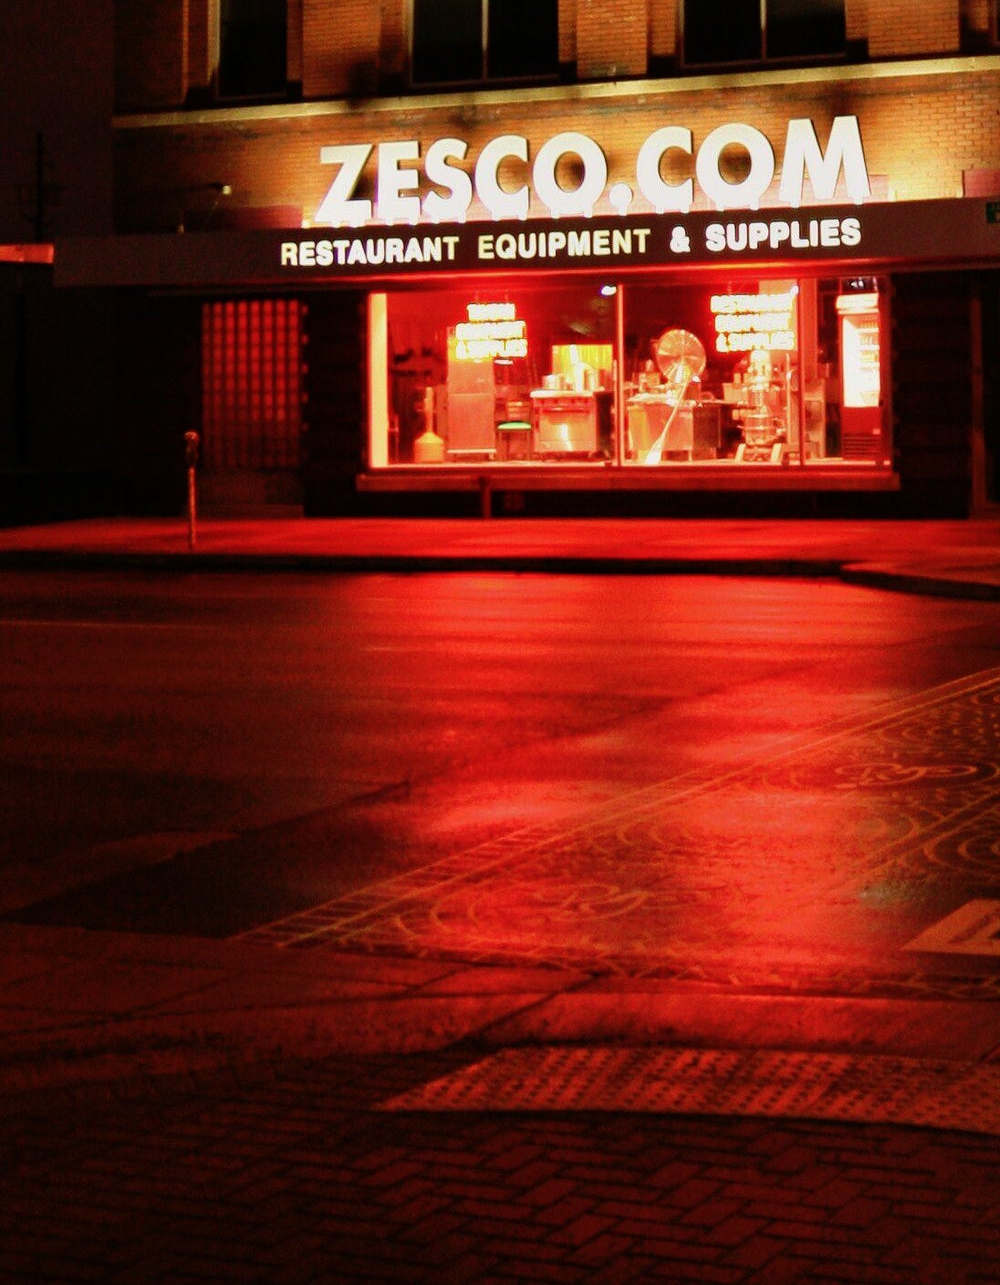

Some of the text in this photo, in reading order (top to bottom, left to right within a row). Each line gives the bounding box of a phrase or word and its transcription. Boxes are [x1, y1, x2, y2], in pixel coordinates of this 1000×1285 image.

[316, 116, 872, 226] ZESCO.COM
[280, 218, 863, 267] RESTAURANT EQUIPMENT & SUPPLIES
